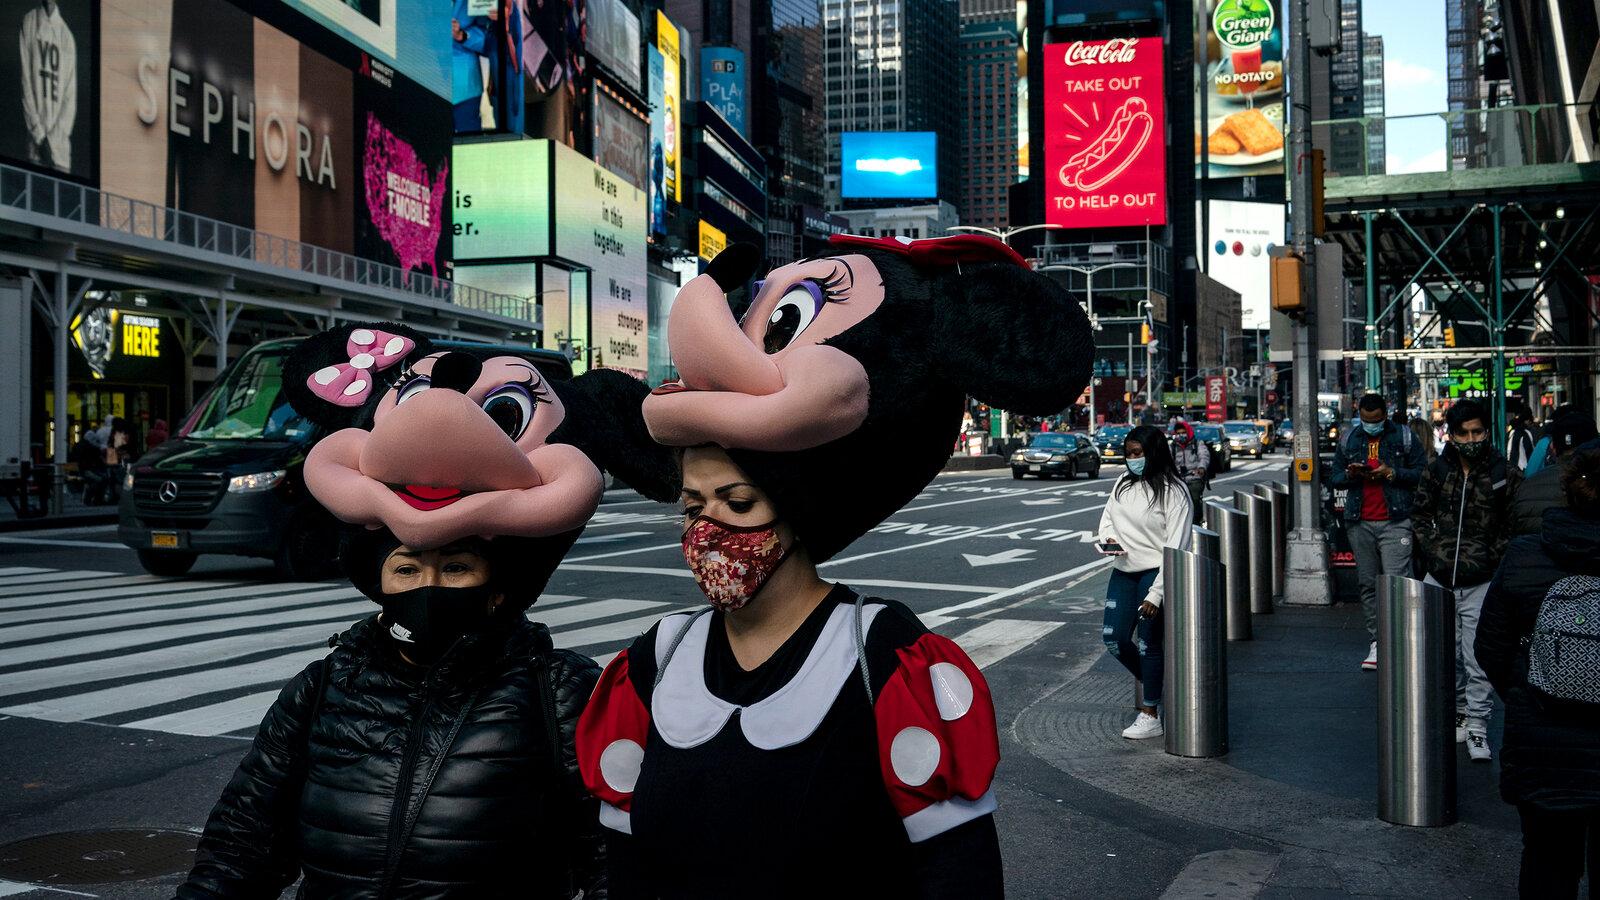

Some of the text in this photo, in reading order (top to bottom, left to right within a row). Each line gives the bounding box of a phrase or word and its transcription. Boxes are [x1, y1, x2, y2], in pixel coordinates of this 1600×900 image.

[1220, 16, 1270, 32] Green
[1226, 28, 1272, 45] Giant
[1064, 37, 1139, 66] Coca-Cola
[1065, 77, 1142, 93] TAKE OUT
[1214, 70, 1275, 85] NO POTATO
[709, 82, 742, 101] PLAY
[138, 54, 336, 190] SEPHORA
[386, 170, 421, 202] WELCOME
[594, 168, 617, 198] We are
[387, 190, 430, 228] T-MOBILE
[455, 190, 472, 208] is
[1054, 192, 1156, 209] TO HELP OUT
[602, 201, 622, 229] in this
[453, 222, 479, 236] er.
[594, 229, 625, 257] together.
[609, 278, 631, 302] We are
[618, 311, 643, 335] stronger
[123, 324, 160, 357] HERE
[609, 337, 639, 360] together.
[1210, 378, 1223, 403] tkts
[868, 522, 981, 536] ONL
[977, 527, 1100, 543] NLY
